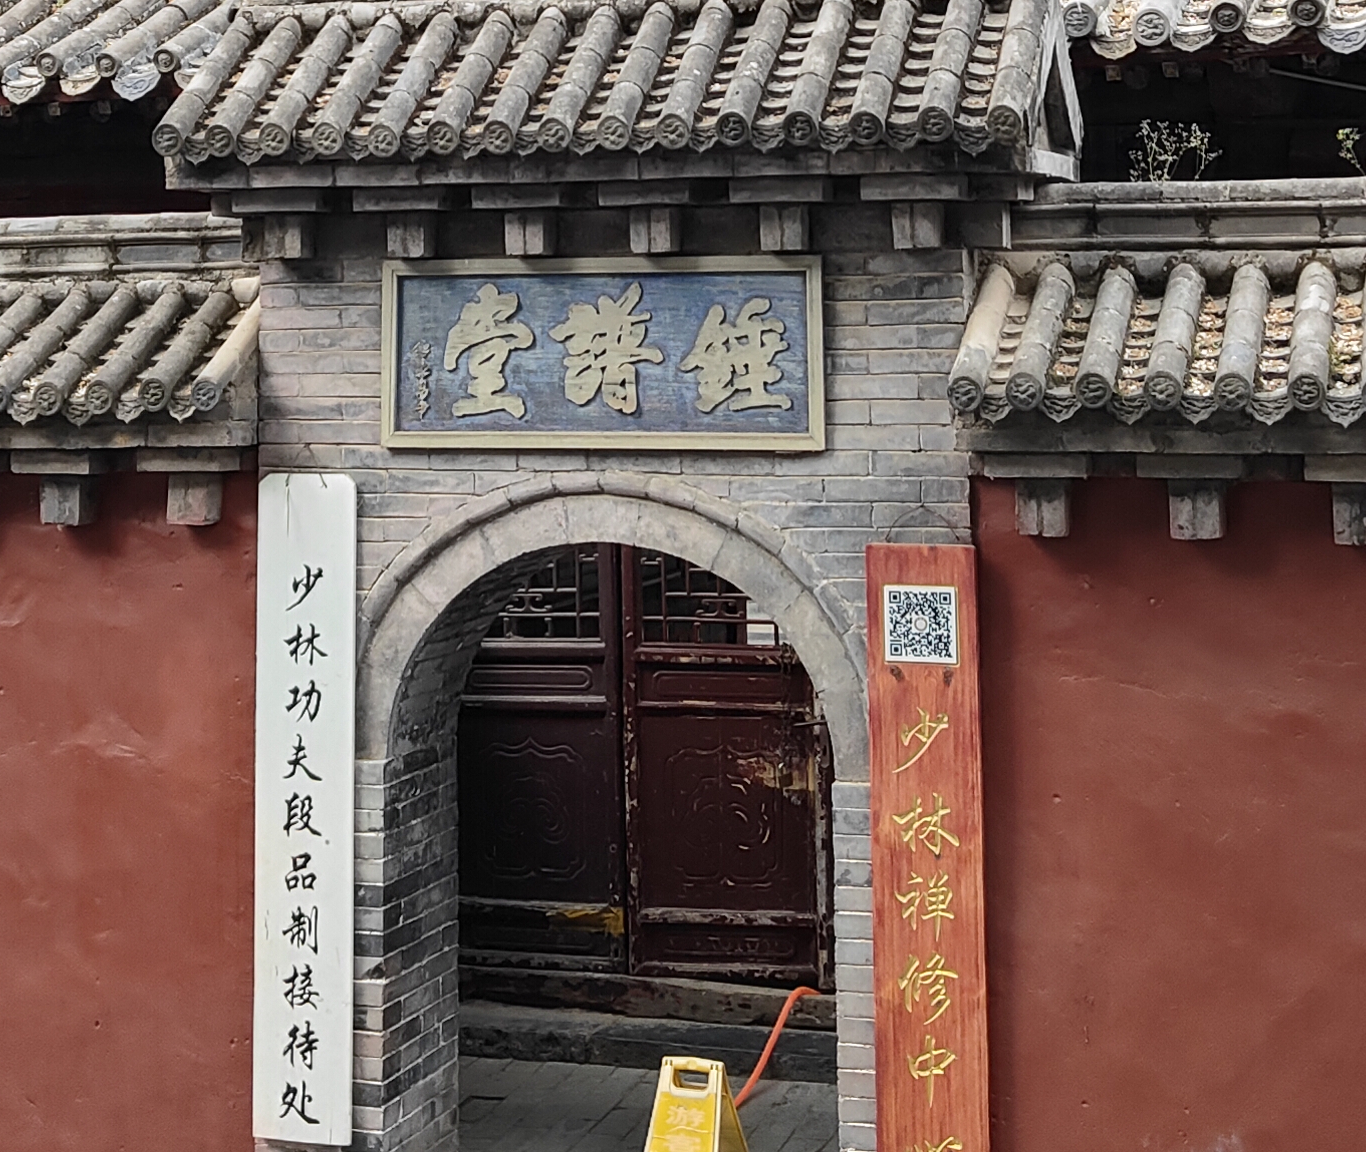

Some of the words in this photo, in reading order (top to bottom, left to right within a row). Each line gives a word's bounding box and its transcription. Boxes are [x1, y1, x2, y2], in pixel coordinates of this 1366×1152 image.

[279, 565, 328, 1126] 少林功夫段品制接待处
[892, 707, 963, 1152] 少林禅修中
